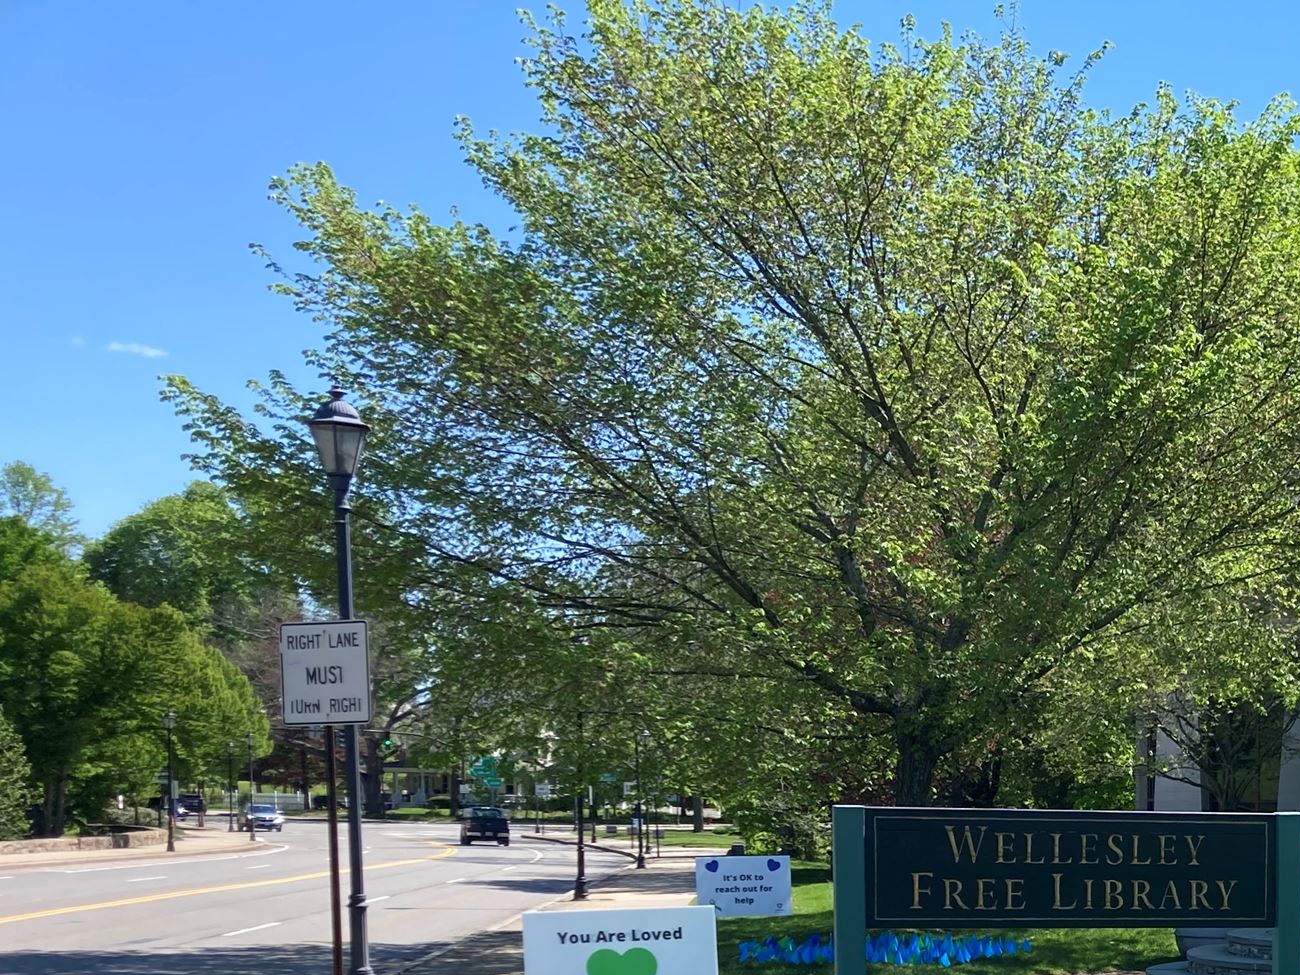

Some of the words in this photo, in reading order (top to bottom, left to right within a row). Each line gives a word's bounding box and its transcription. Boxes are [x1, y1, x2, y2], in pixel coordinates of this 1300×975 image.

[286, 633, 321, 650] RIGHT
[328, 632, 359, 649] LANE
[305, 665, 343, 685] MUST
[945, 825, 1206, 865] WELLESLEY
[723, 874, 737, 882] It's
[909, 872, 1027, 910] FREE
[1052, 873, 1238, 910] LIBRARY
[735, 897, 754, 905] help
[557, 931, 590, 944] You
[596, 930, 626, 943] Are
[631, 927, 683, 942] Loved
